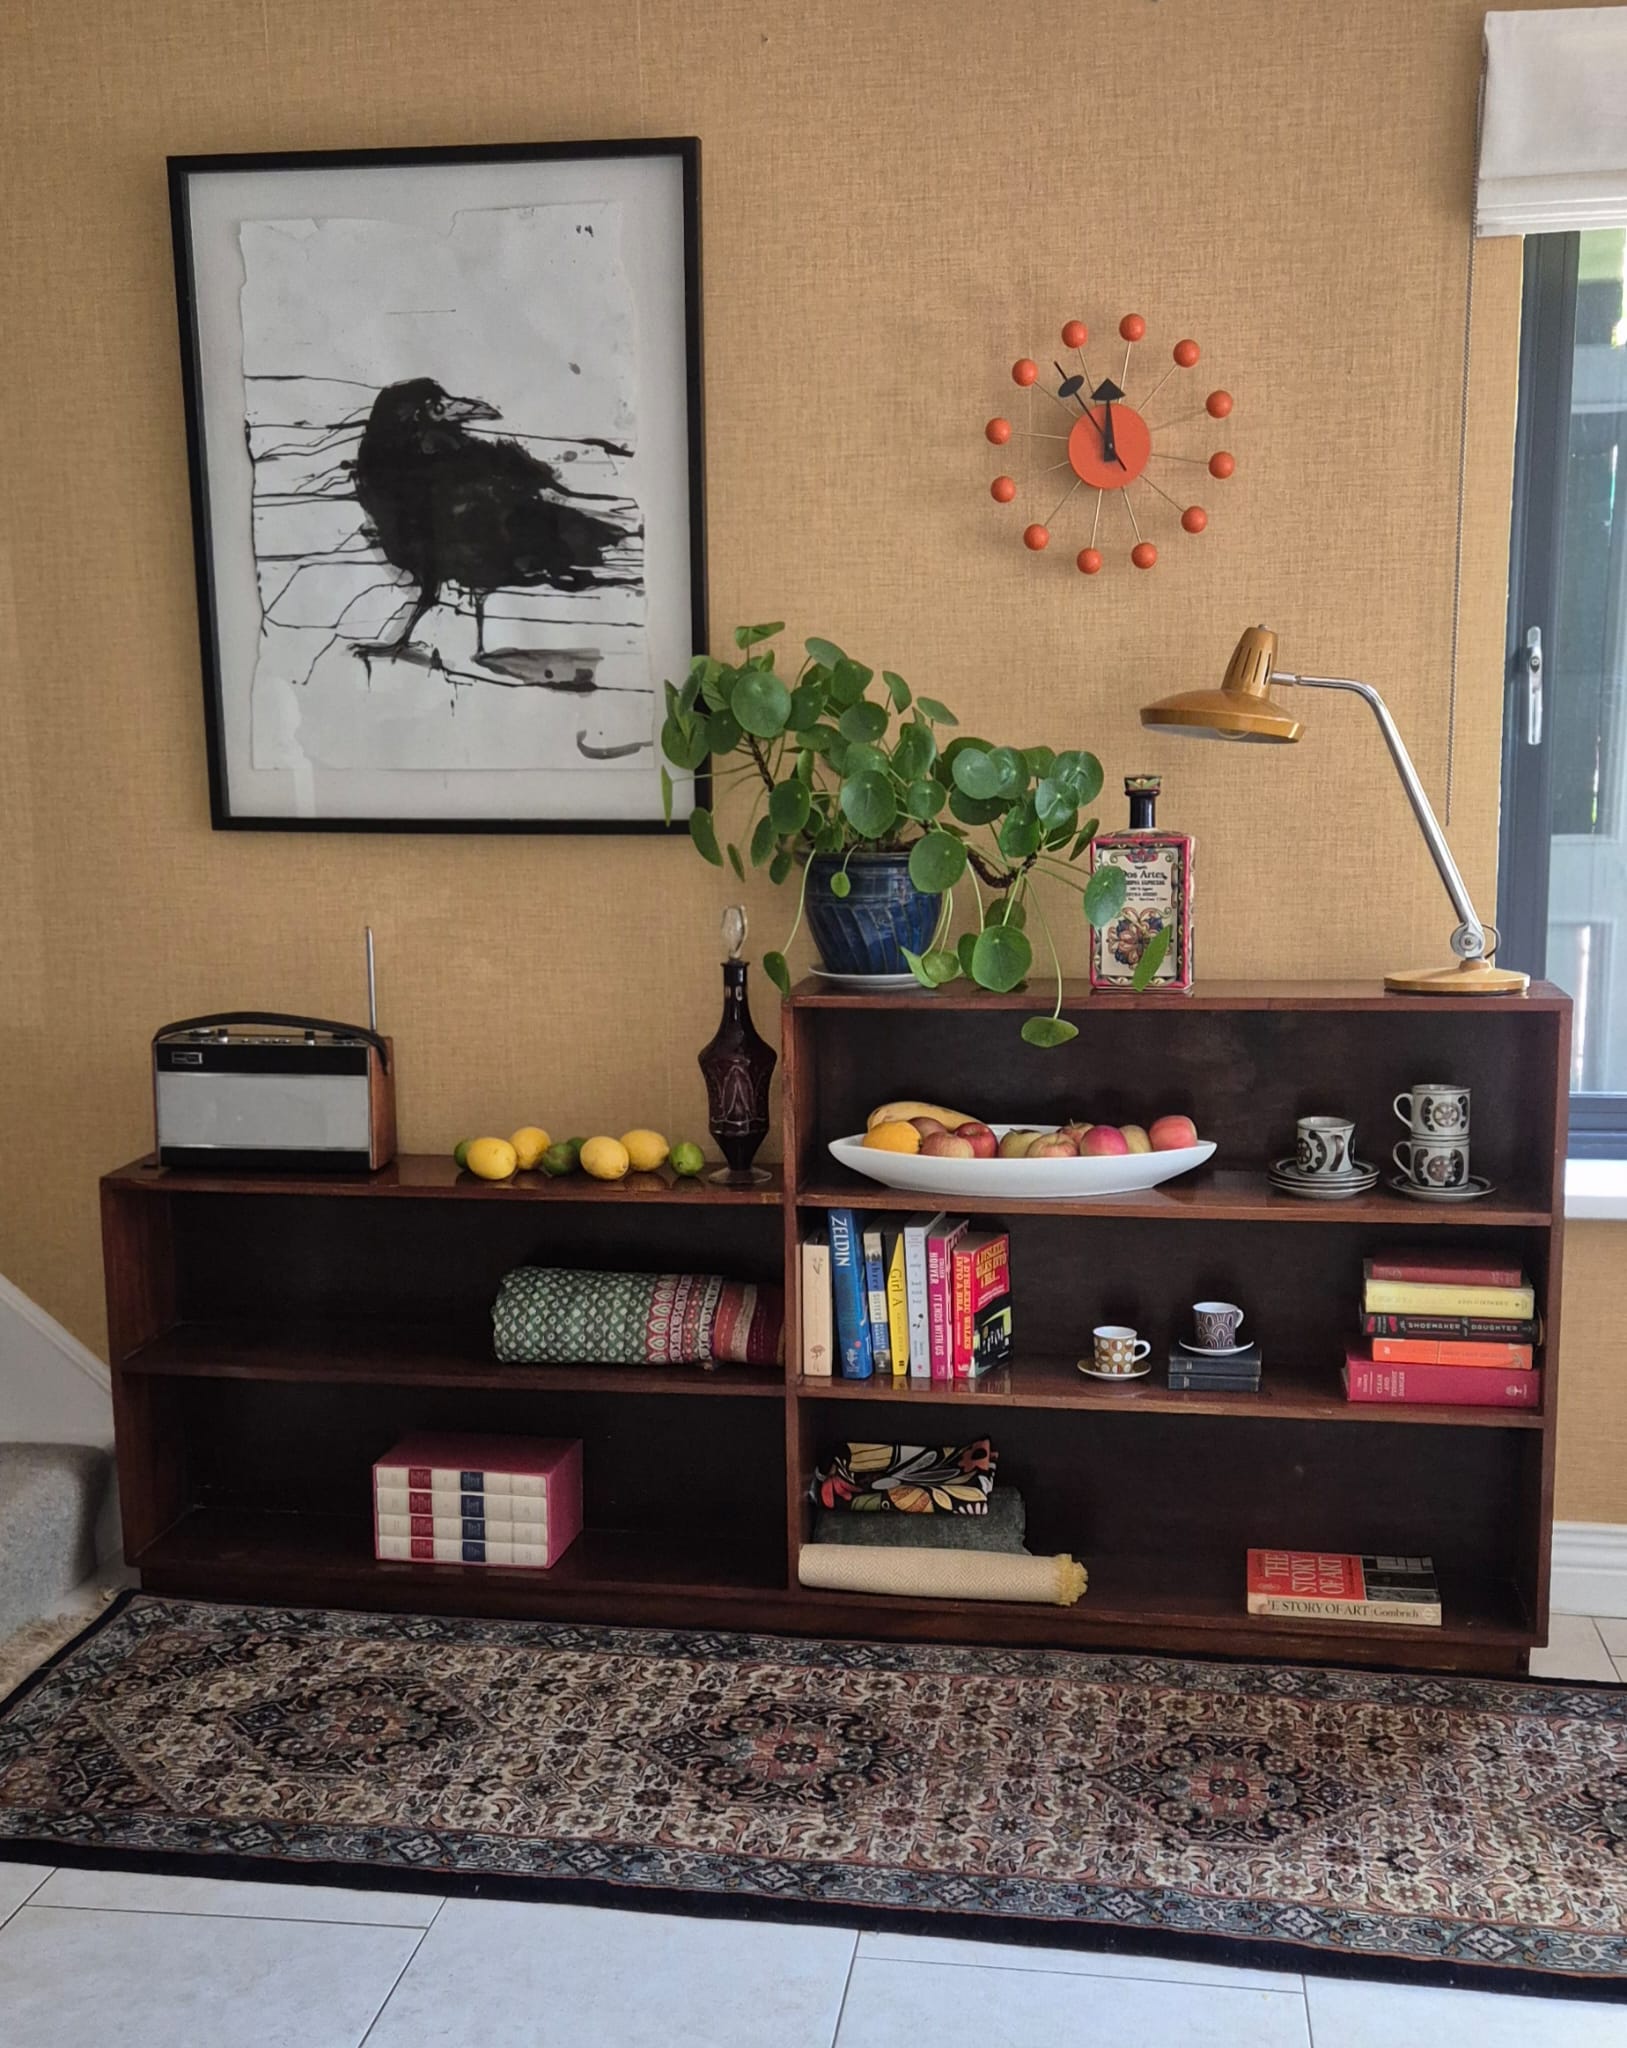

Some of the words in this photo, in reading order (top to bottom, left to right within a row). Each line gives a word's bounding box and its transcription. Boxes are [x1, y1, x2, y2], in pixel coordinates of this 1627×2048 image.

[831, 1215, 851, 1266] ZELDIN
[929, 1252, 939, 1284] HOOVER
[891, 1268, 903, 1292] Girl
[956, 1281, 963, 1289] A
[873, 1293, 882, 1320] SISTERS
[893, 1299, 903, 1307] A
[933, 1303, 943, 1323] ENDS
[934, 1325, 943, 1344] WITH
[935, 1345, 944, 1356] US
[1265, 1553, 1289, 1577] THE
[1291, 1555, 1317, 1593] STORY
[1318, 1556, 1343, 1580] ART
[1320, 1579, 1344, 1594] OF
[1282, 1600, 1322, 1613] STORY
[1325, 1603, 1341, 1615] OF
[1344, 1604, 1369, 1616] ART
[1373, 1607, 1420, 1618] Gombrich
